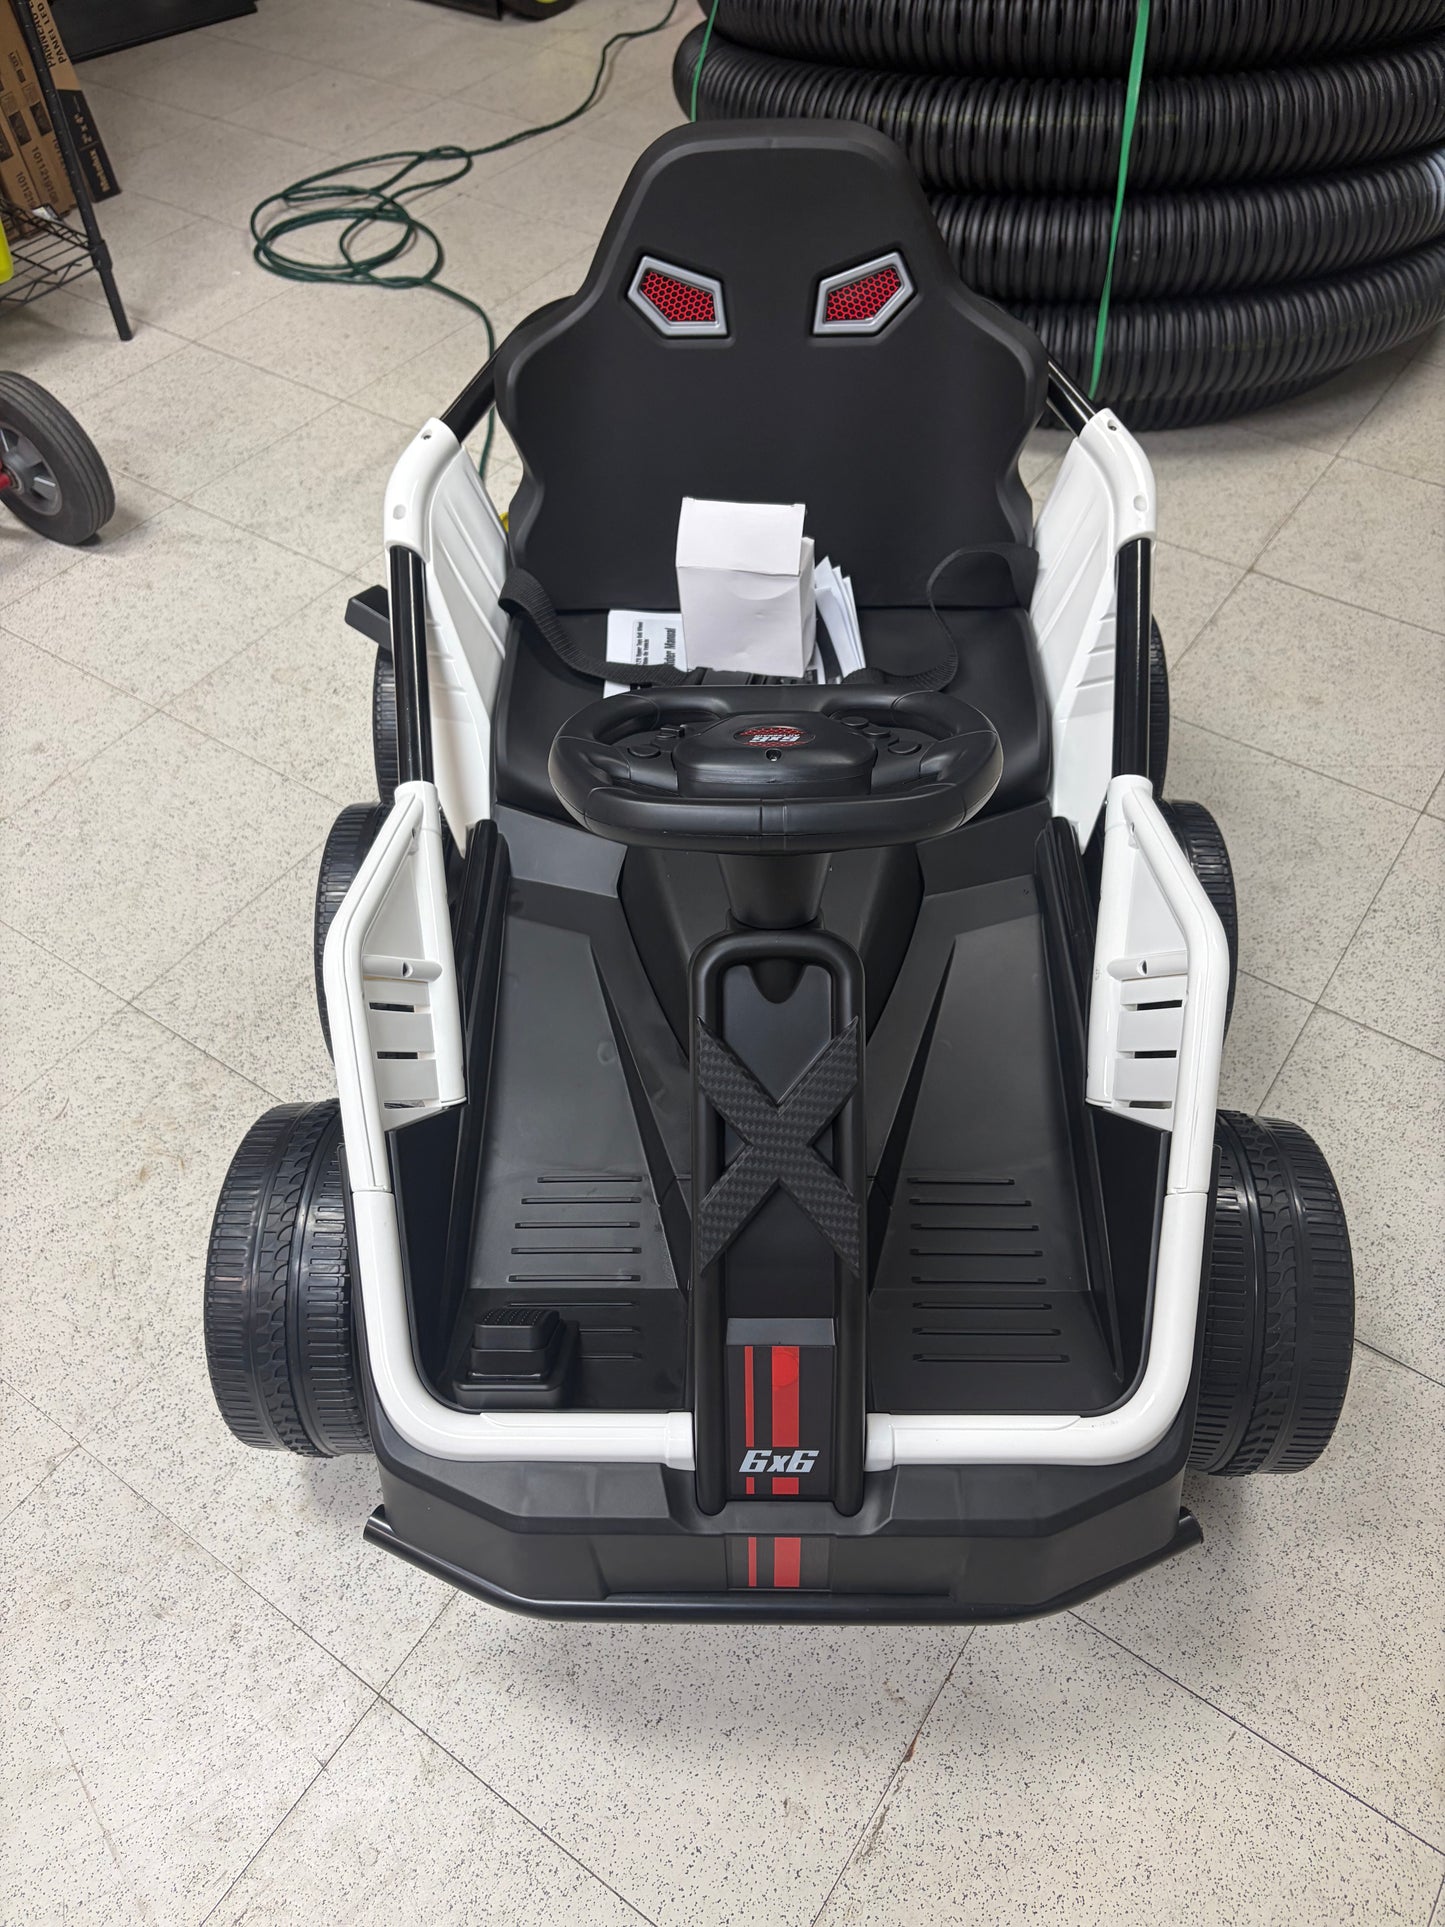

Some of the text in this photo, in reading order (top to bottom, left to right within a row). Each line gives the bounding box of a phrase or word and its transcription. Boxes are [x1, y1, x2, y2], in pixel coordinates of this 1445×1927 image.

[33, 12, 56, 68] PANNEAU
[37, 2, 67, 64] PANEL LED
[664, 627, 676, 650] Manual
[739, 1449, 820, 1473] 6x6
